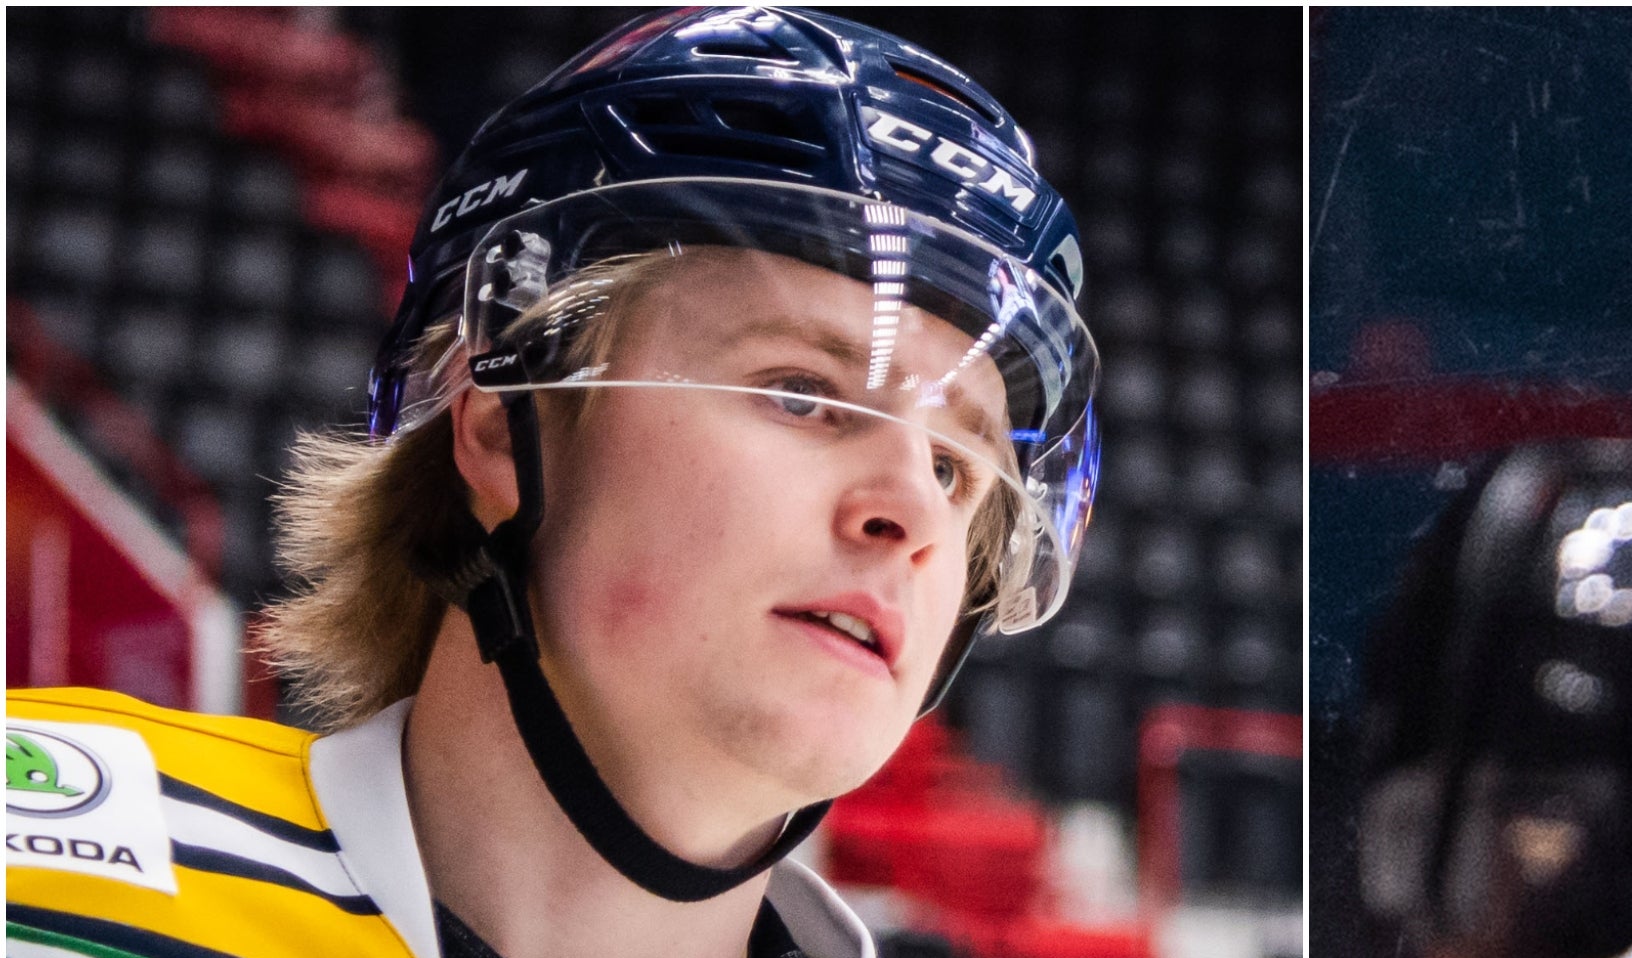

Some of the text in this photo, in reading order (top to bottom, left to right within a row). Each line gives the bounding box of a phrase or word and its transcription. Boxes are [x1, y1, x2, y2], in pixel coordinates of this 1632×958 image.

[866, 107, 1036, 214] CCM
[431, 169, 529, 233] CCM
[474, 353, 518, 373] CCM
[6, 834, 145, 874] KODA
